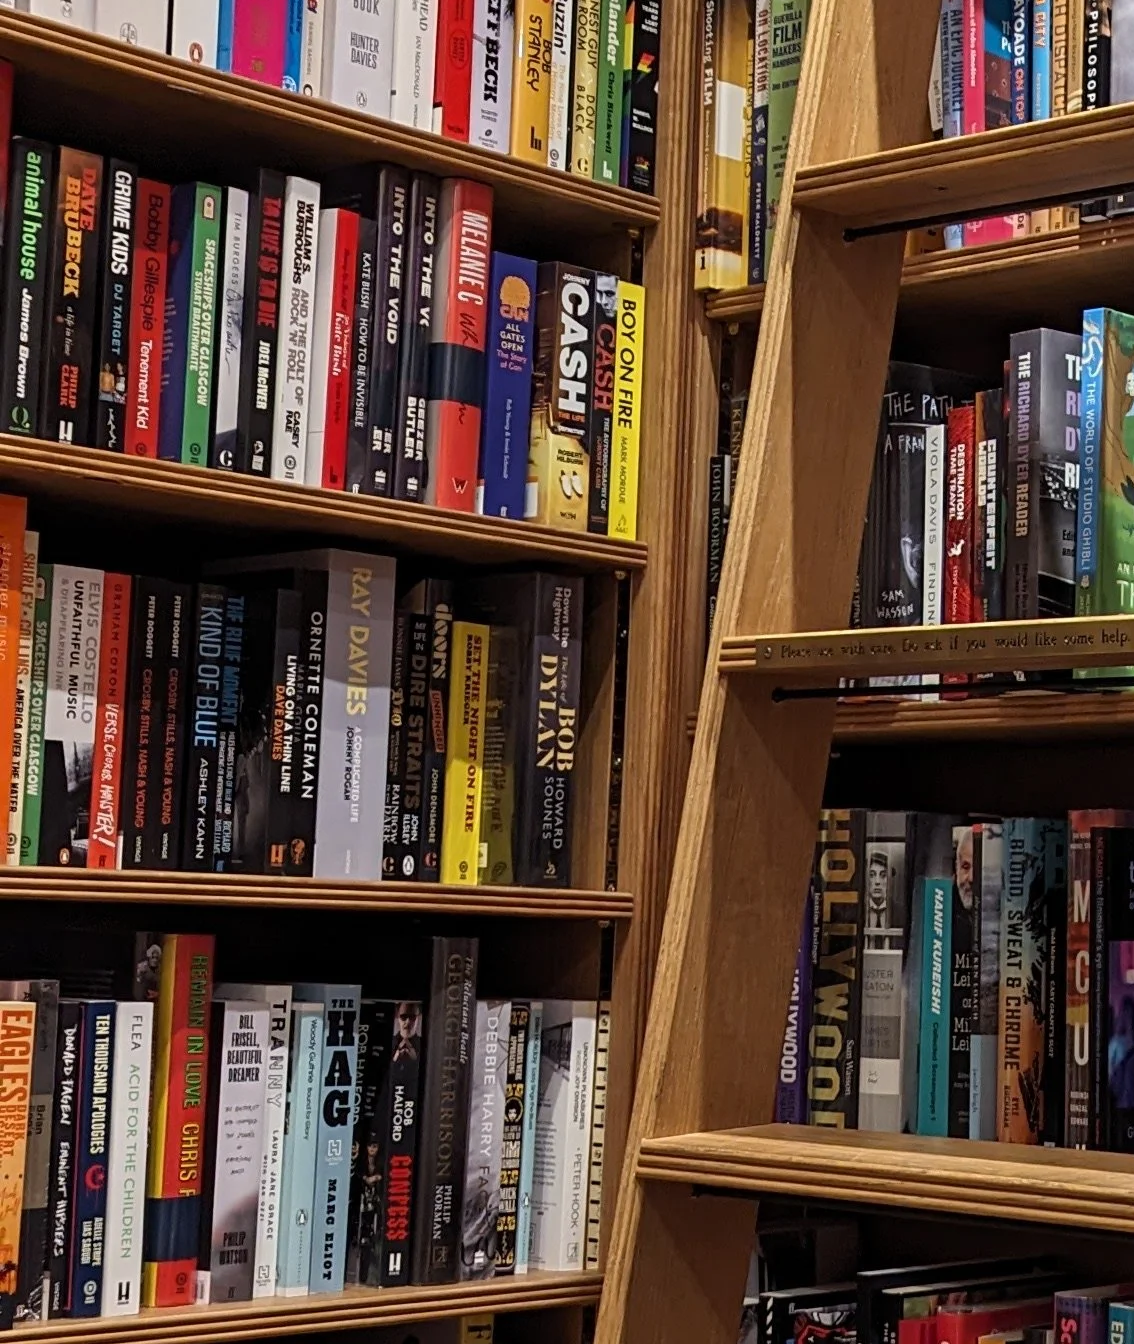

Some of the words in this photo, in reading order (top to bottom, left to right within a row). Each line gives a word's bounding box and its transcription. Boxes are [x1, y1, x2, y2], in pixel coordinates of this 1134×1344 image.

[482, 39, 500, 103] BECK
[24, 151, 43, 217] animal
[112, 170, 133, 228] GRIME
[20, 220, 40, 281] house
[110, 229, 129, 275] KIDS
[20, 288, 33, 344] James
[621, 298, 637, 344] BOY
[16, 346, 31, 399] Brown
[558, 282, 590, 416] CASH
[619, 347, 636, 380] ON
[617, 383, 634, 429] FIRE
[1084, 410, 1095, 449] WORLD
[1082, 476, 1093, 514] STUDIO
[1081, 517, 1092, 572] GHIBLI
[349, 566, 373, 617] RAY
[345, 625, 370, 717] DAVIES
[323, 1011, 358, 1128] HAG
